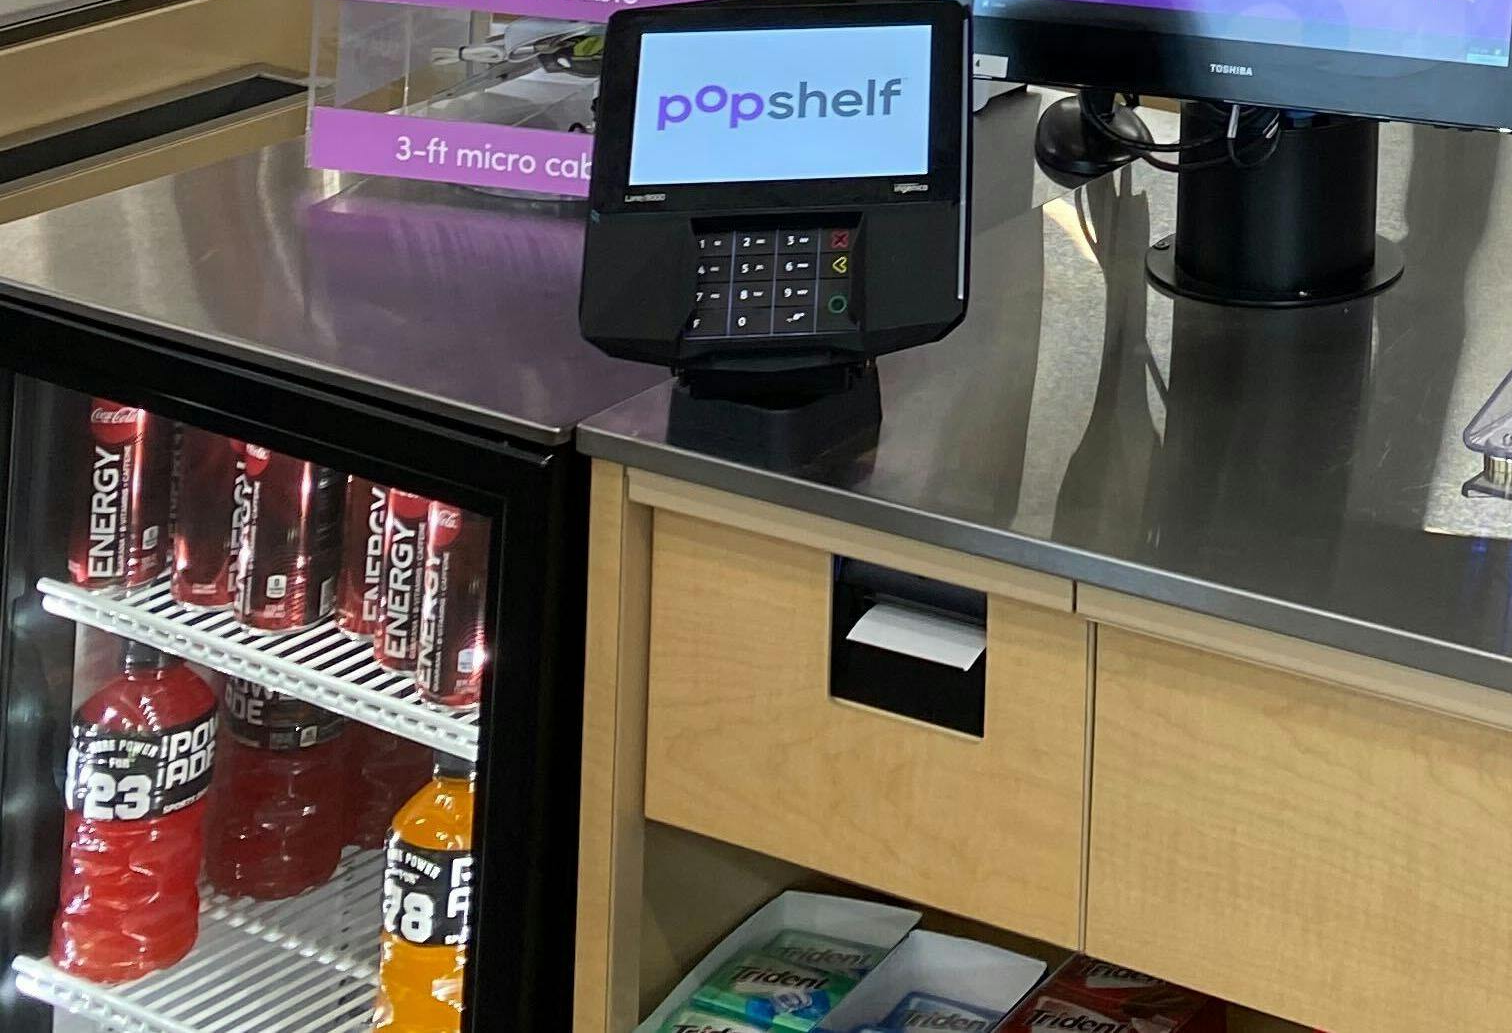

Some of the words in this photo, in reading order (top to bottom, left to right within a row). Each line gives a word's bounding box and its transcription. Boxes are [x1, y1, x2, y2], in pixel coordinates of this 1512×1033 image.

[1210, 63, 1254, 77] TOSHIBA
[656, 78, 902, 131] popshelf
[395, 136, 449, 165] 3-ft
[456, 144, 537, 174] micro
[545, 152, 592, 180] cab
[700, 239, 705, 249] 1
[743, 237, 751, 247] 2
[787, 235, 795, 246] 3
[698, 265, 706, 274] 4
[741, 263, 749, 273] 5
[785, 261, 793, 272] 6
[696, 292, 703, 301] 7
[740, 289, 748, 300] 8
[784, 287, 792, 298] 9
[737, 316, 747, 327] 0
[122, 445, 132, 482] CAFFEINE
[87, 446, 120, 578] ENERGY
[119, 489, 129, 524] VITAMINS
[416, 522, 426, 560] CAFFEINE
[440, 552, 450, 591] CAFFEINE
[384, 518, 416, 659] ENERGY
[413, 568, 423, 605] VITAMINS
[437, 598, 447, 637] VITAMINS
[433, 651, 443, 692] GUARANA
[119, 740, 159, 758] POWER
[83, 772, 152, 820] 23
[405, 852, 441, 880] POWER
[732, 967, 830, 990] Trident
[903, 1010, 998, 1033] Trident
[1026, 1009, 1132, 1033] Trident
